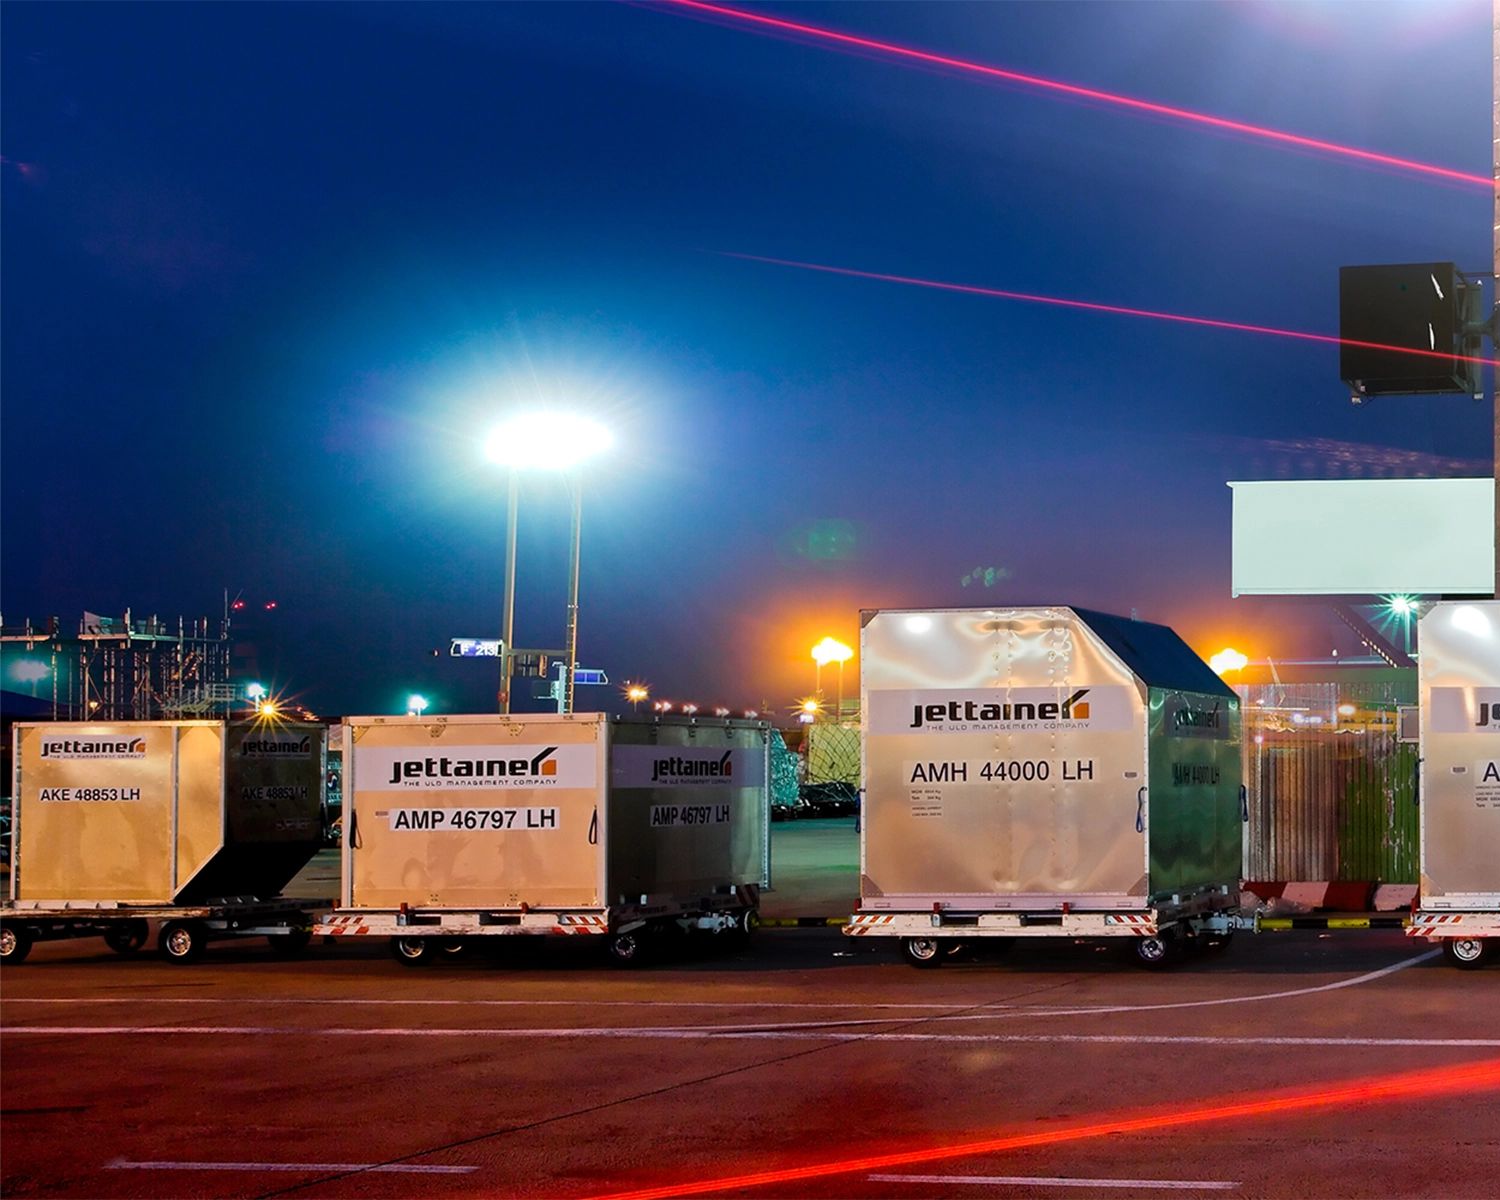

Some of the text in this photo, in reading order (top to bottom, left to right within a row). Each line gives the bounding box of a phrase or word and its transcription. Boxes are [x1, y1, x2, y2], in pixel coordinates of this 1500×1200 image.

[910, 690, 1090, 728] jettainer
[1044, 722, 1090, 730] COMPANY
[41, 738, 142, 757] jettainer
[242, 736, 310, 755] jettainer
[389, 747, 558, 784] jettainer
[651, 750, 732, 781] jettainer
[911, 760, 1093, 783] AMH 44000 LH
[40, 788, 140, 801] AKE 48853 LH
[394, 809, 555, 829] AMP 46797 LH
[653, 805, 729, 825] AMP 46797 LH
